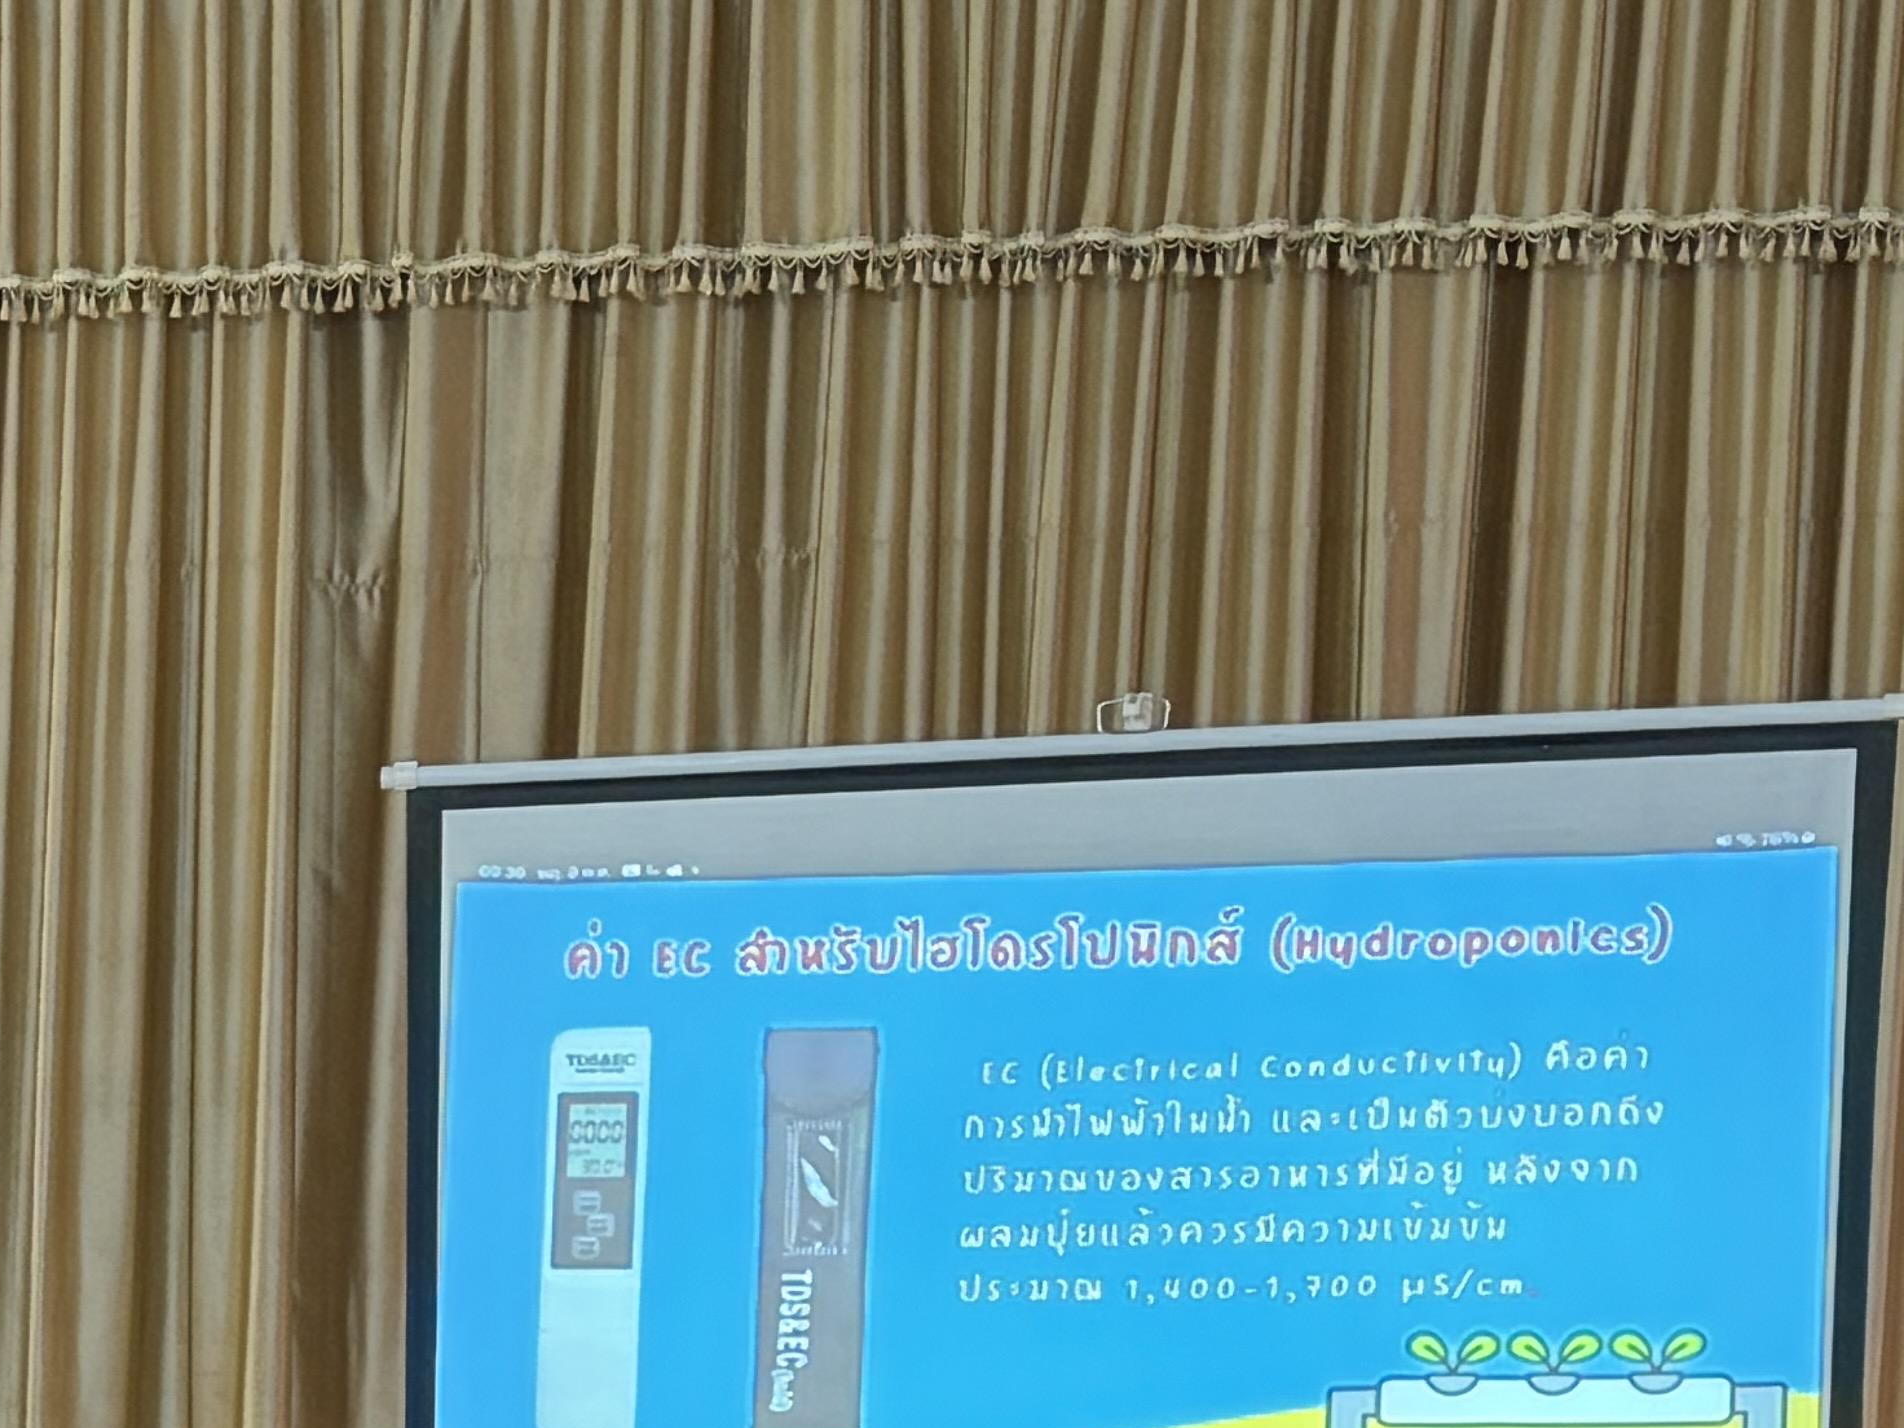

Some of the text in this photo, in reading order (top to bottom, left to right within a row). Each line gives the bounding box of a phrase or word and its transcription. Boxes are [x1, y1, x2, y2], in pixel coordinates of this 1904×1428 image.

[564, 903, 1674, 980] ค่า EC สำหรับไฮโดรโปนิกส์ (Hydroponics)
[981, 1061, 1020, 1086] EC
[1040, 1052, 1238, 1091] (Electrical
[1260, 1042, 1523, 1080] Conductivity)
[959, 1272, 1103, 1303] ประมาณ
[1126, 1274, 1377, 1305] 1,400-1,700
